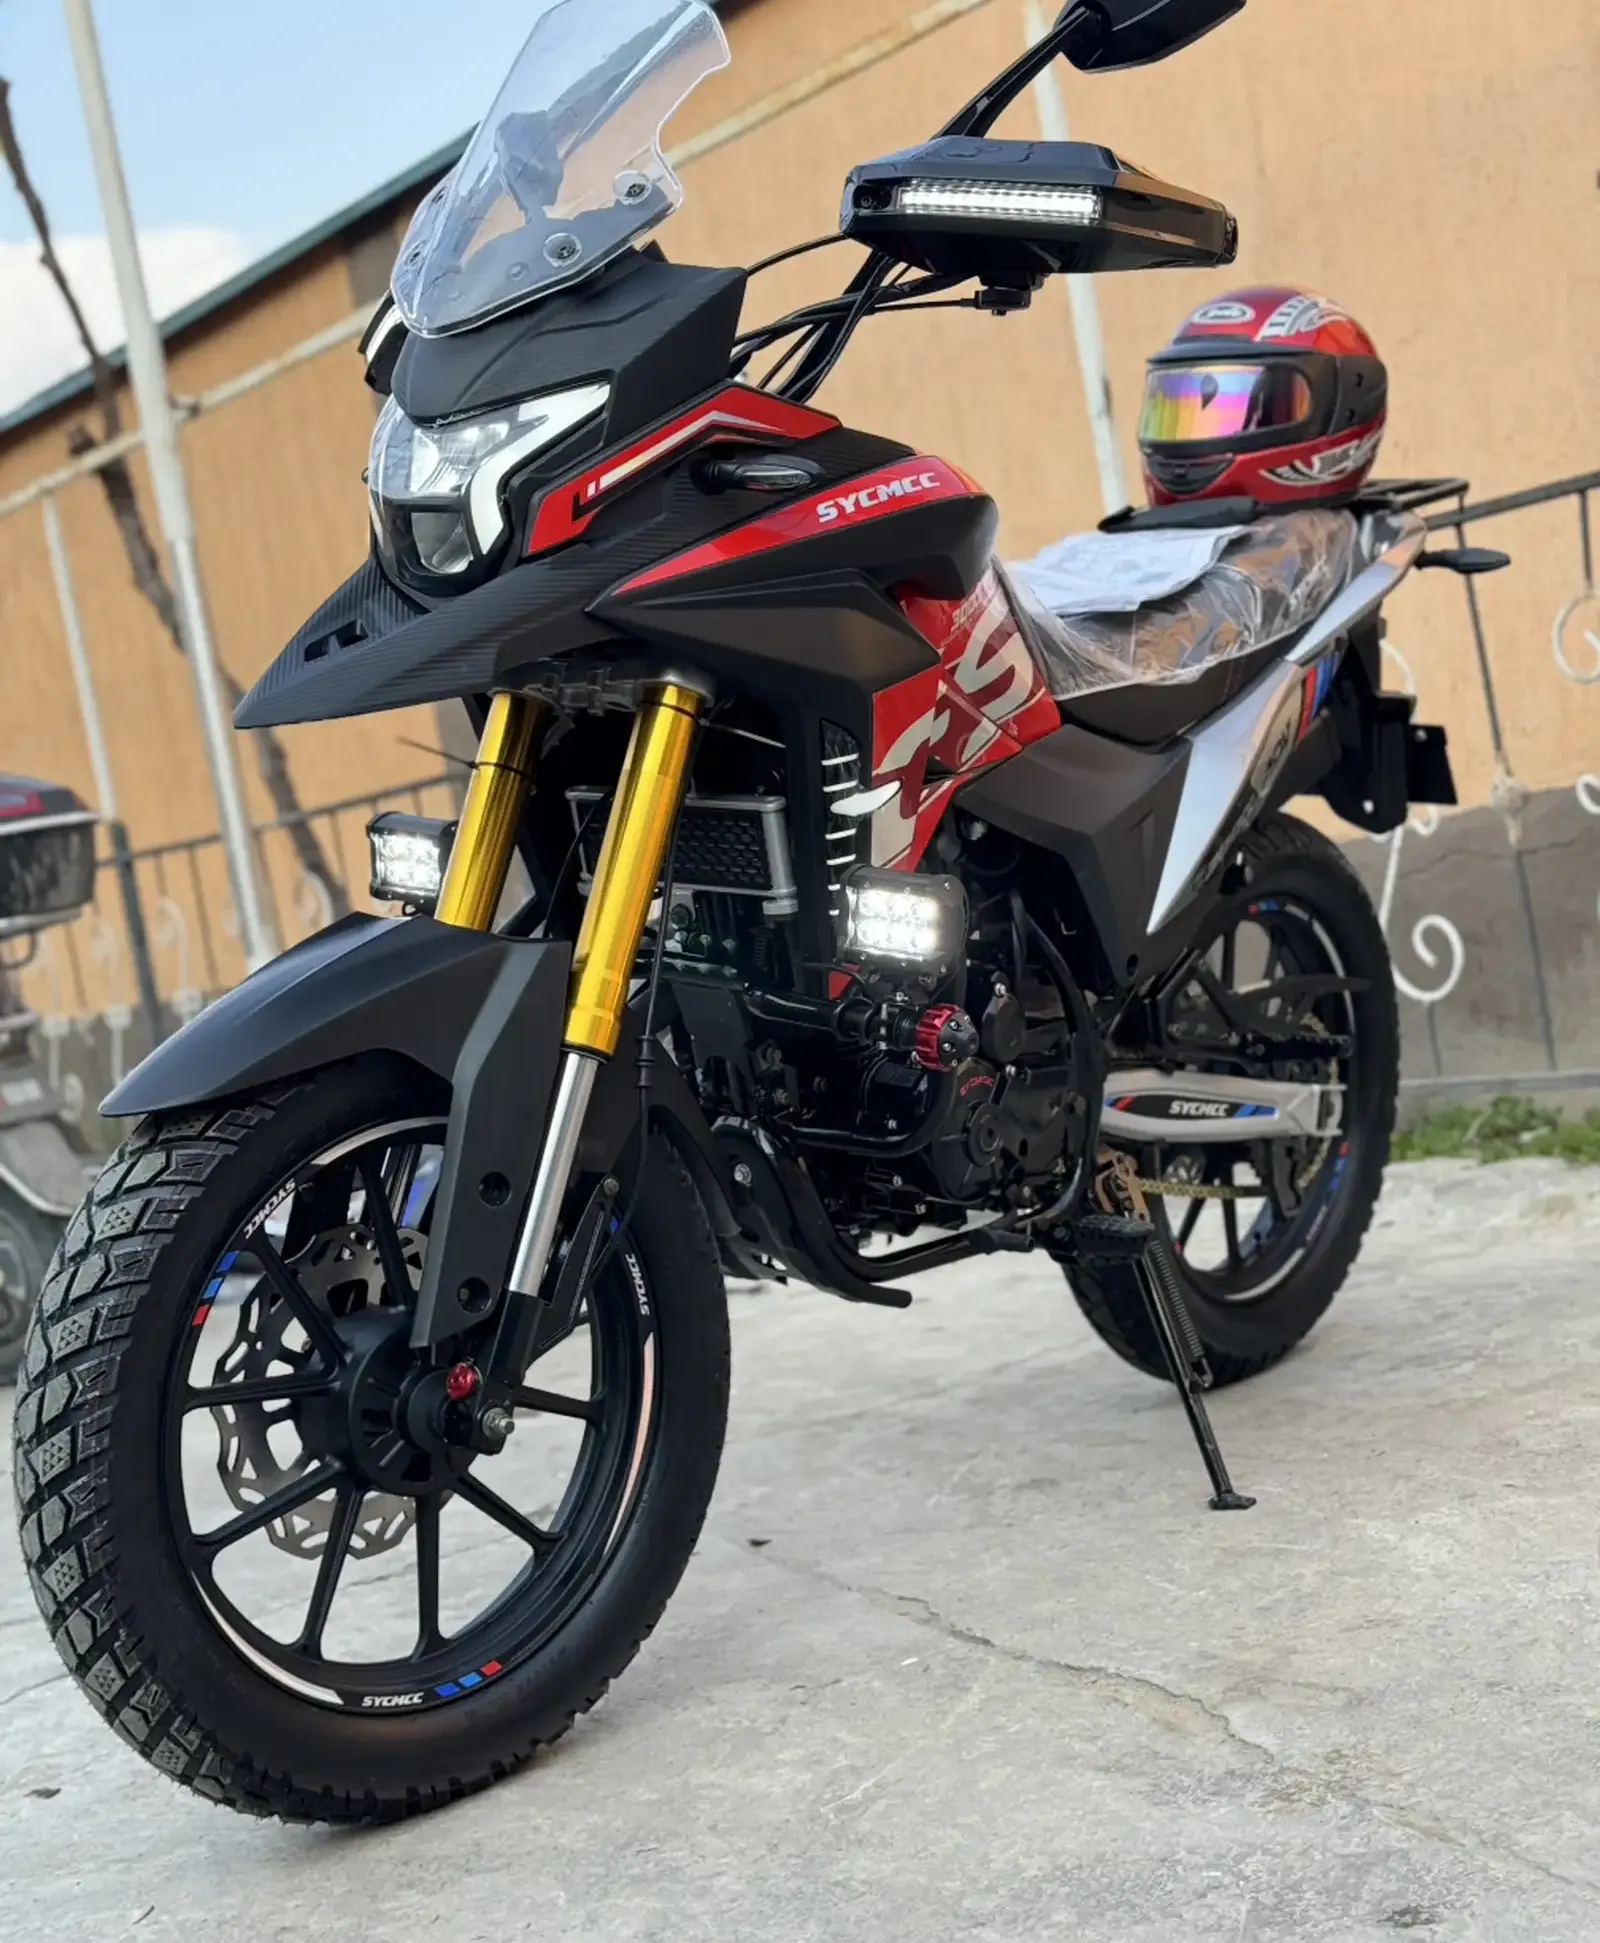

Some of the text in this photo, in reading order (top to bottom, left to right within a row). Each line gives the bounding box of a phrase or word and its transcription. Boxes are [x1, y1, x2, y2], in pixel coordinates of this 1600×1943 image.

[815, 472, 941, 524] SYCMCC
[1168, 1099, 1231, 1117] SYCMCC
[243, 1178, 296, 1240] SYCMCC
[625, 1253, 650, 1316] SYCMCC
[361, 1692, 425, 1708] SYCMCC
